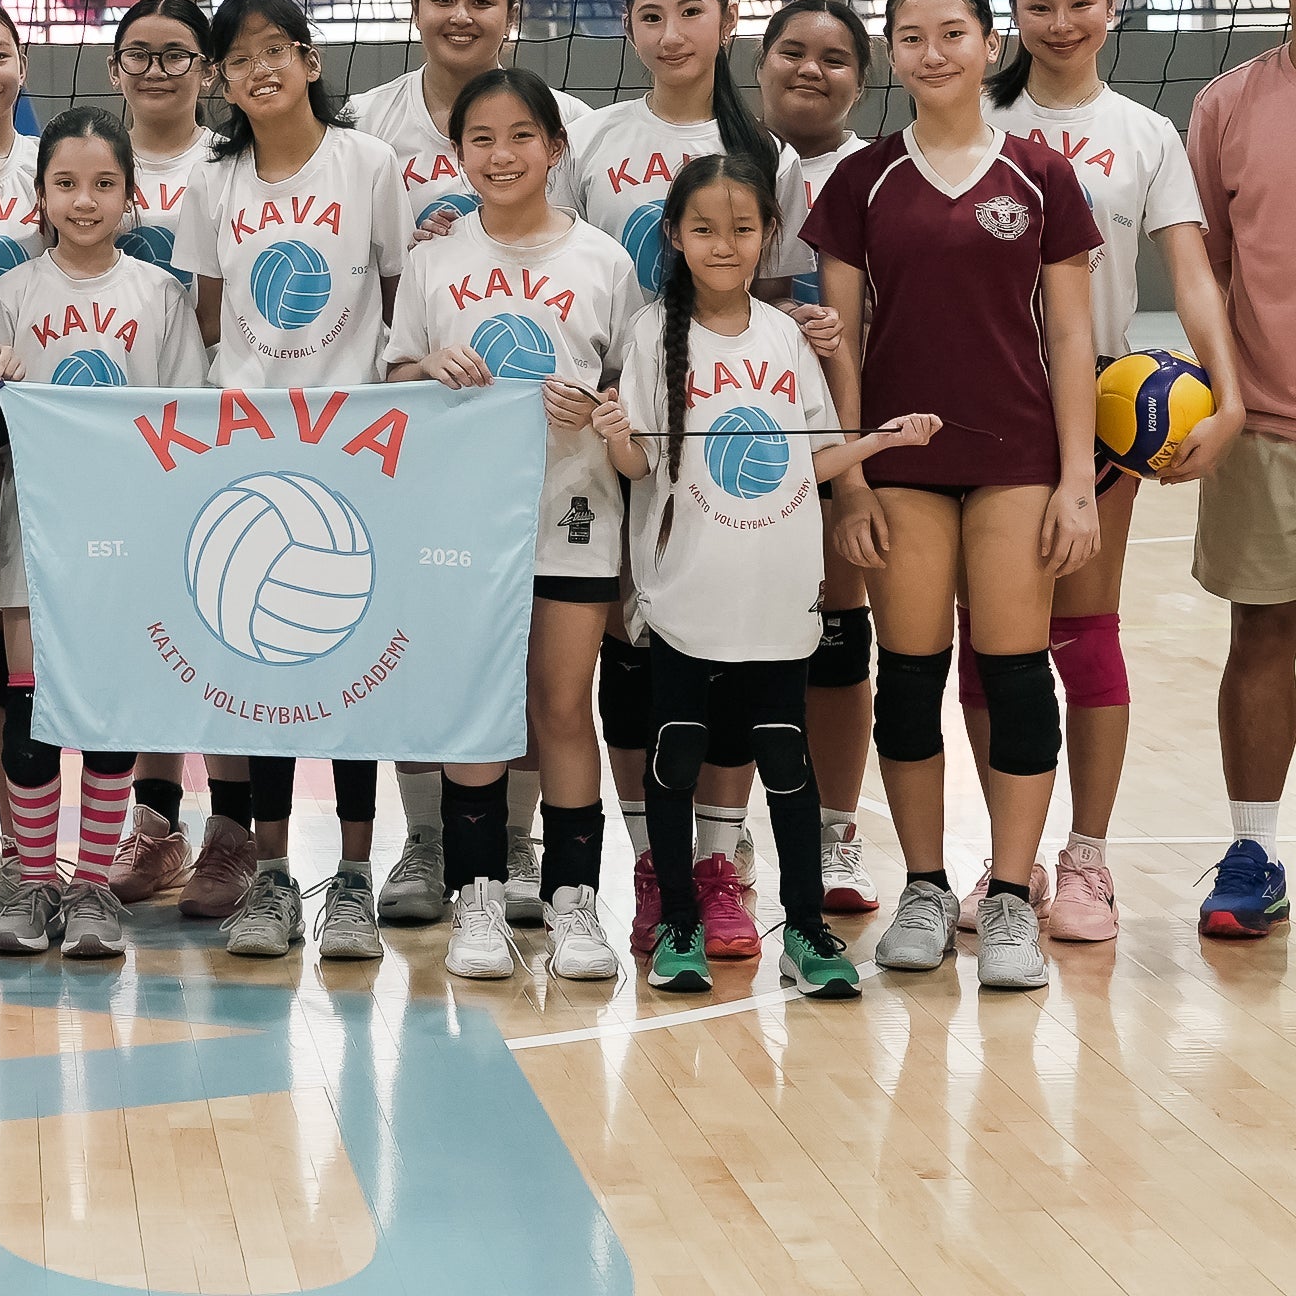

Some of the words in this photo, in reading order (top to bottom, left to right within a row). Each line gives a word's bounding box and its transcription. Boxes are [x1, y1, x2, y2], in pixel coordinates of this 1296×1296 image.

[404, 154, 458, 191] KA
[608, 153, 690, 194] KA
[1028, 129, 1115, 177] AVA
[231, 195, 342, 244] KAVA
[1112, 214, 1134, 228] 2026
[351, 265, 369, 275] 202
[448, 268, 576, 322] KAVA
[31, 302, 139, 353] KAVA
[237, 315, 257, 344] KAITO
[258, 343, 317, 359] VOLLEYBALL
[321, 307, 352, 348] ACADEMY
[684, 359, 796, 409] KAVA
[133, 388, 410, 479] KAVA
[1147, 396, 1157, 432] V300W
[1149, 440, 1180, 468] KAVA
[688, 482, 710, 513] KAITO
[714, 512, 775, 530] VOLLEYBALL
[780, 477, 812, 519] ACADEMY
[87, 540, 129, 559] EST.
[419, 547, 473, 568] 2026
[146, 620, 197, 685] KAITO
[203, 682, 333, 725] VOLLEYBALL
[342, 628, 413, 709] ACADEMY
